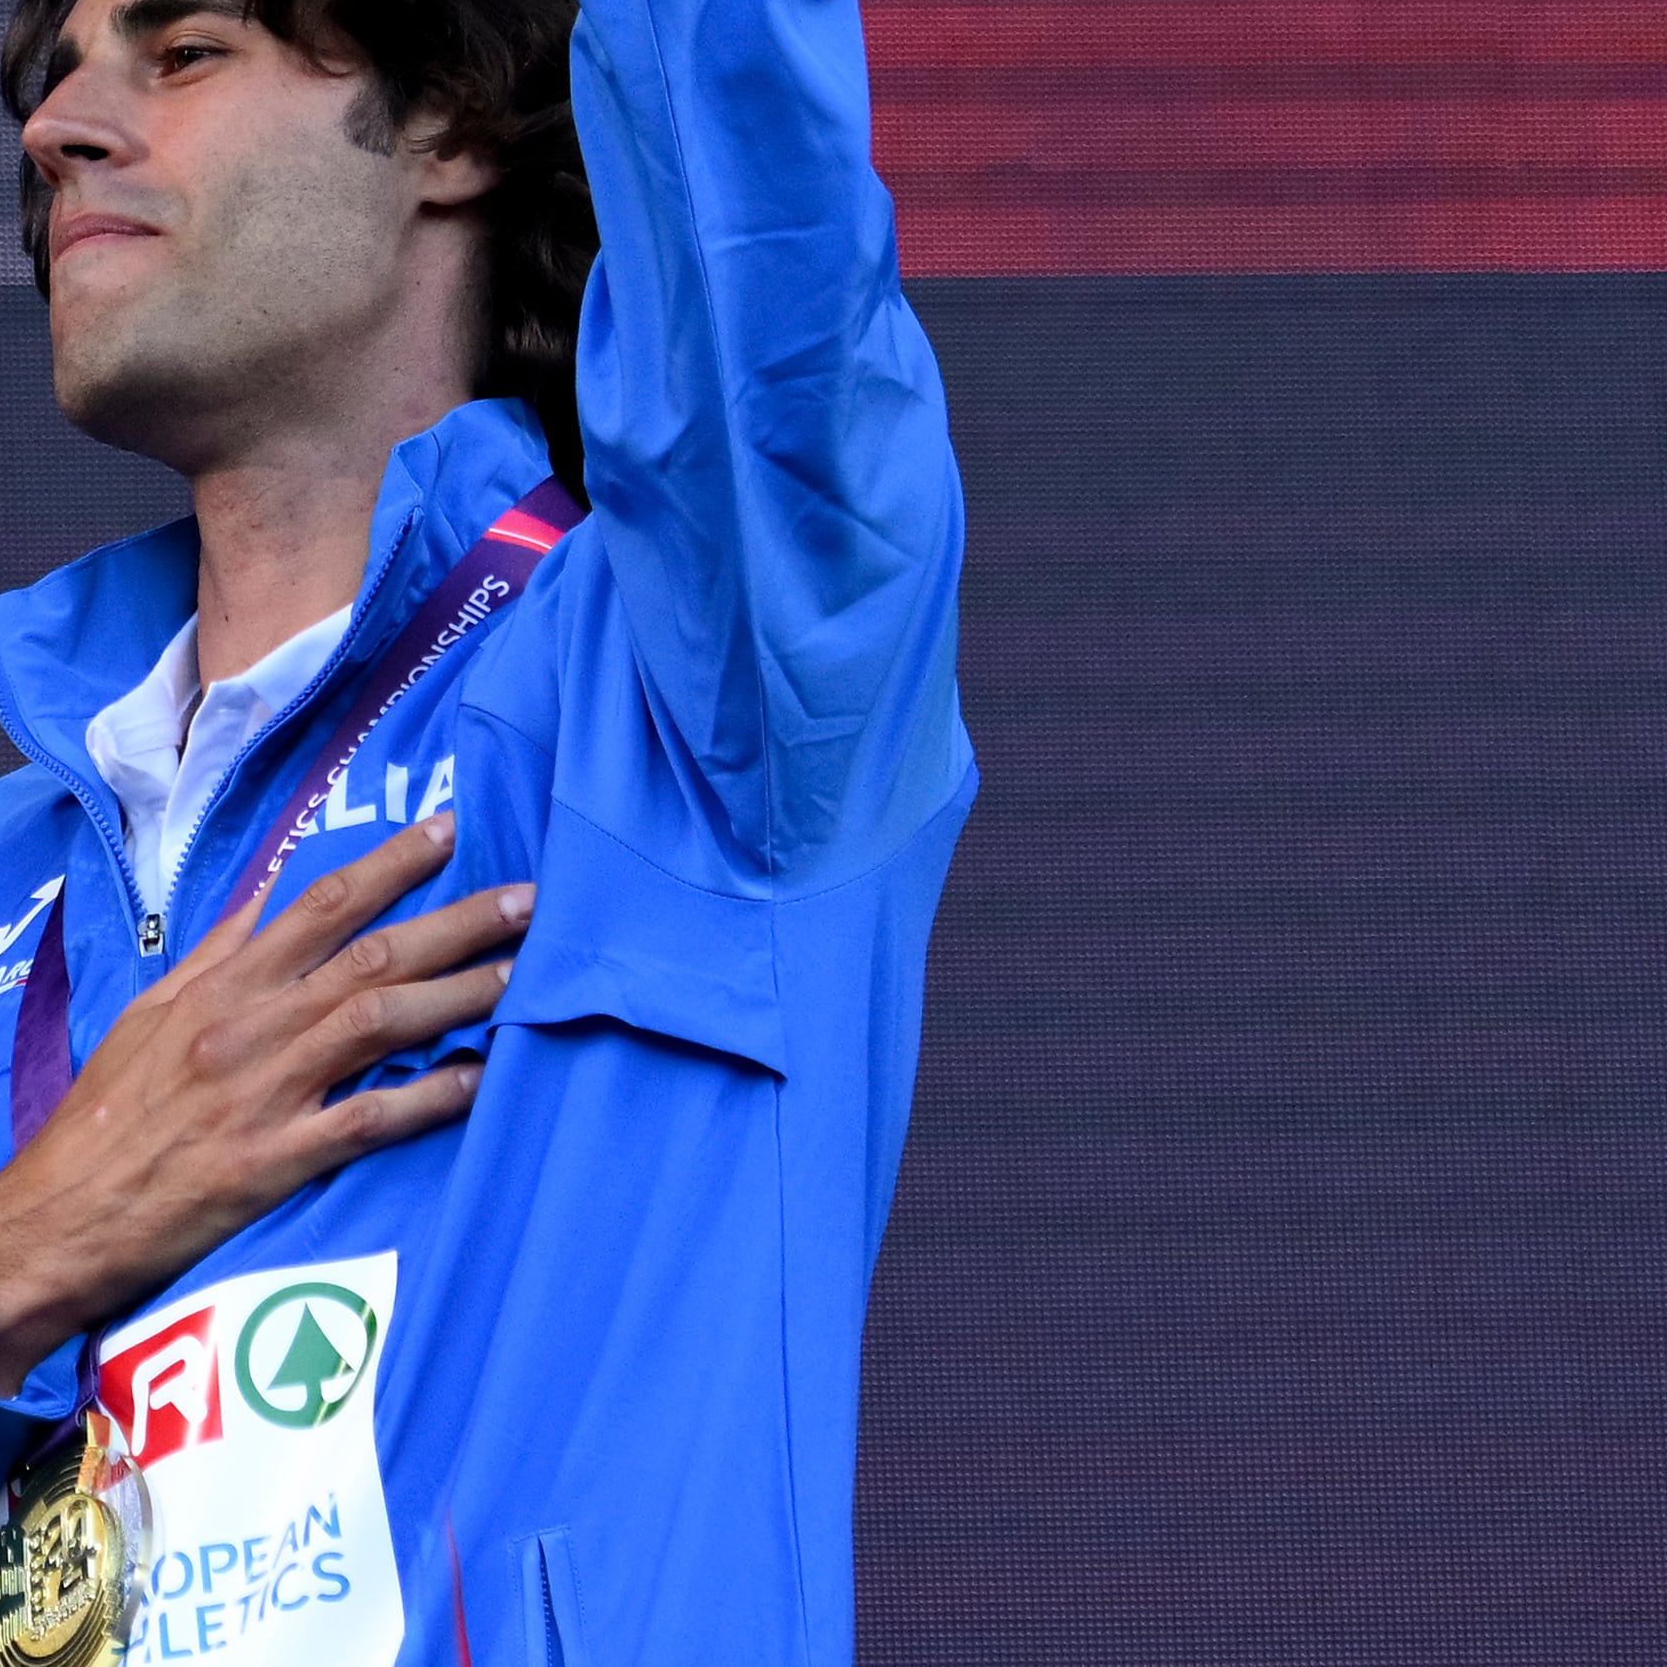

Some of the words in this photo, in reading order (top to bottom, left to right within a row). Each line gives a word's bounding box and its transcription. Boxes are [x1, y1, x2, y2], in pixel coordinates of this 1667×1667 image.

[254, 792, 328, 896] ETICS
[301, 753, 456, 839] LIA
[142, 1491, 342, 1607] OPEAN
